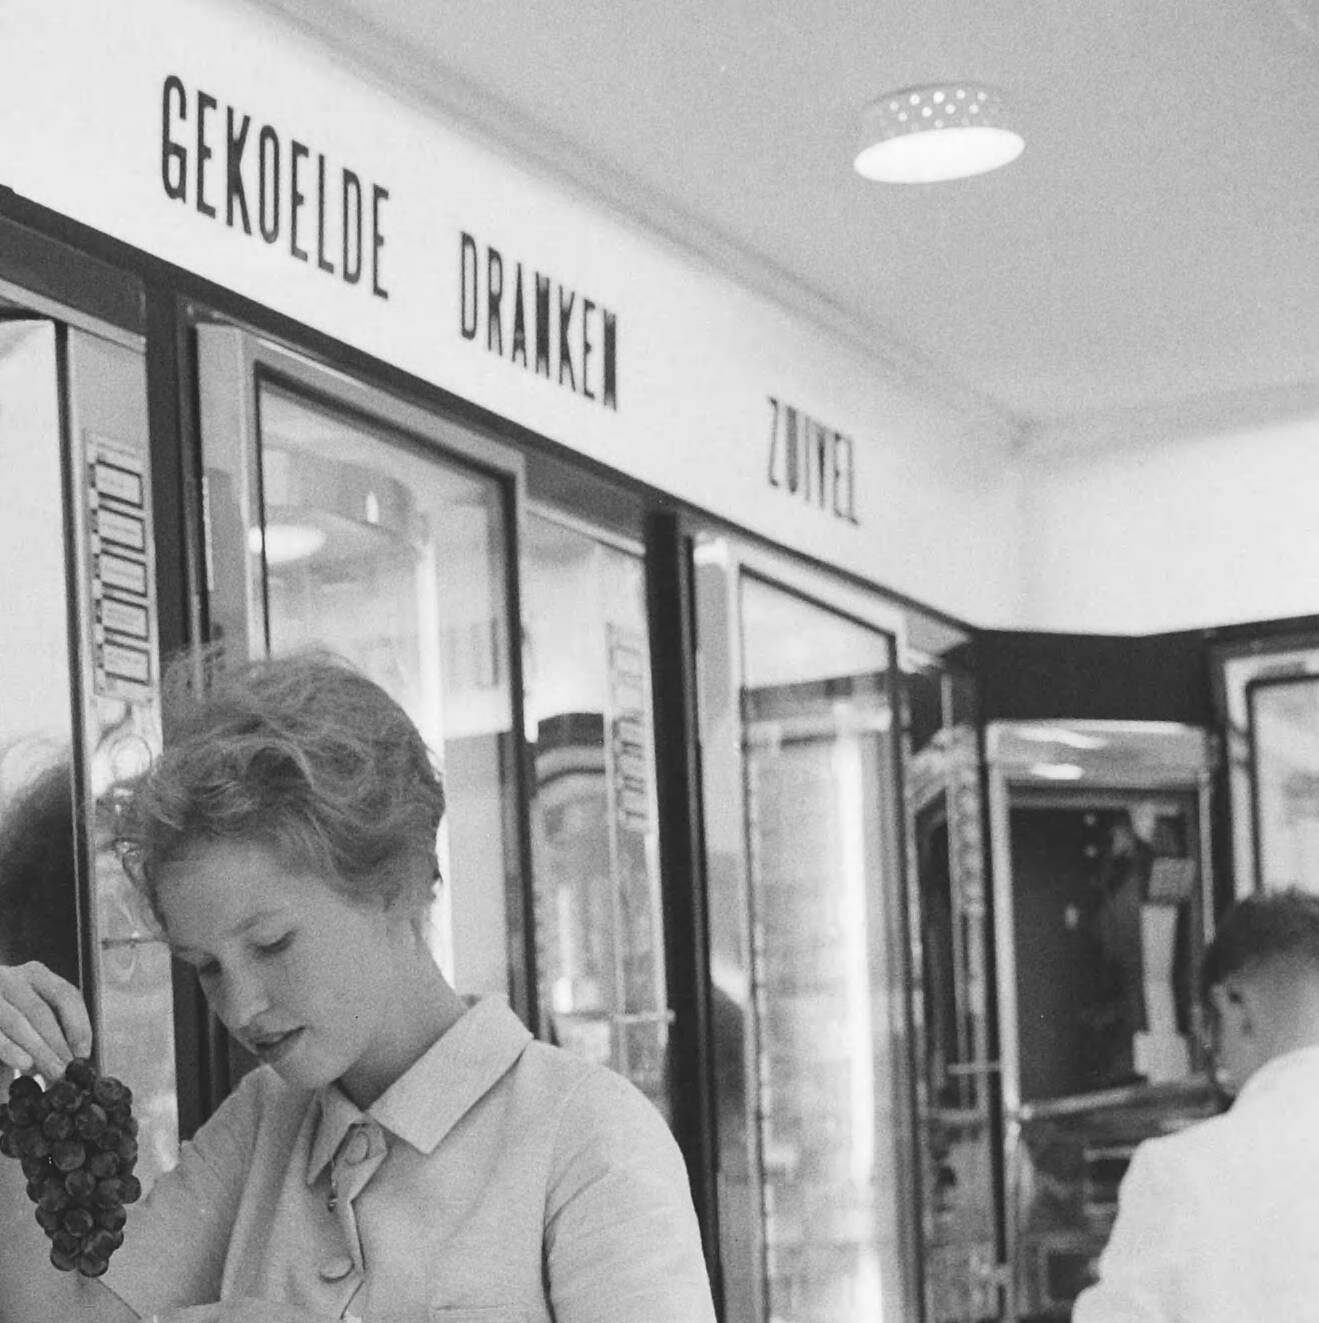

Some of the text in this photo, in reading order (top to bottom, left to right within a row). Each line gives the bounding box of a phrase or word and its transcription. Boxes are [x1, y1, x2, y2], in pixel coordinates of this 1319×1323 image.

[161, 74, 617, 413] GEKOELDE DRANKEN
[768, 397, 860, 526] ZUIVEL
